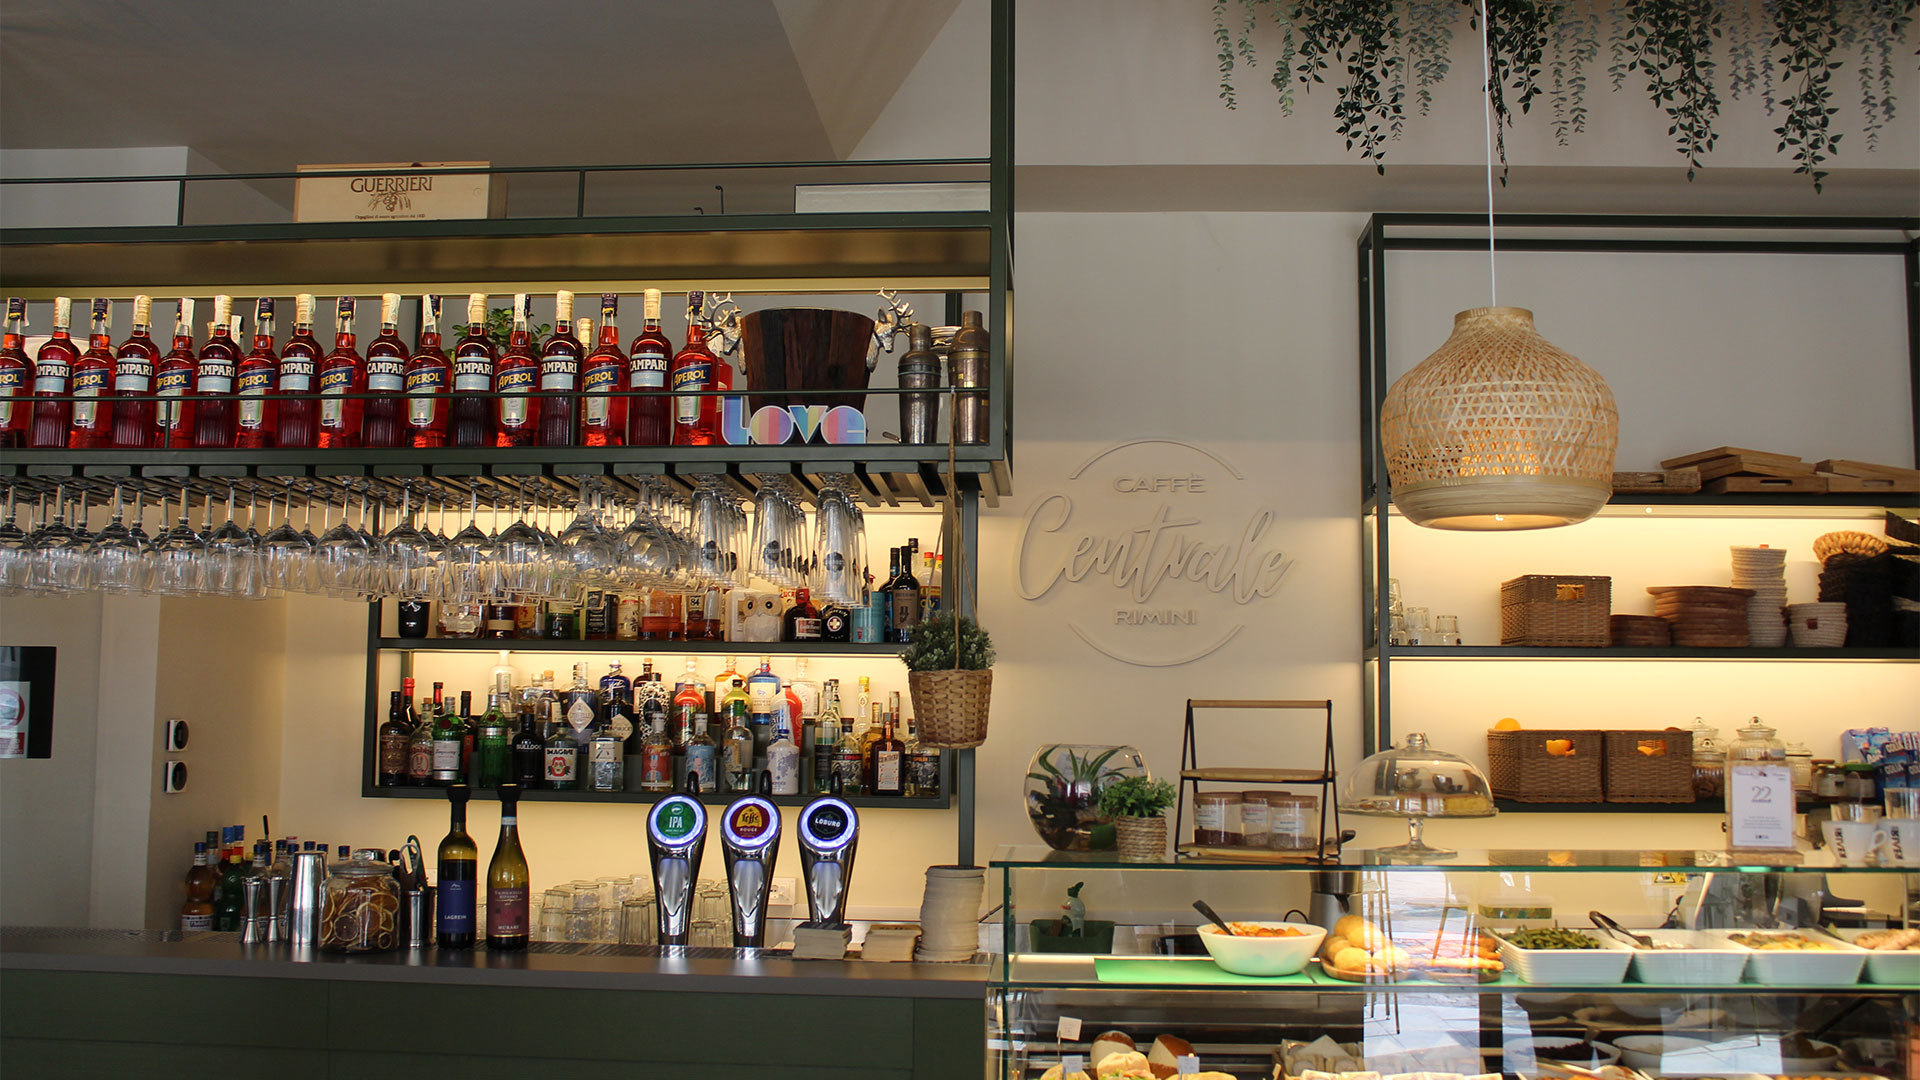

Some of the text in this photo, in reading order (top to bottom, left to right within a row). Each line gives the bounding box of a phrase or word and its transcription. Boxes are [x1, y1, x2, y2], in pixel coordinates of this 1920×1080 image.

[351, 176, 433, 192] GUERRIERI
[36, 365, 70, 378] AMPARI
[115, 363, 153, 376] AMPARI
[280, 362, 314, 375] AMPARI
[366, 362, 404, 374] CAMPAR
[0, 373, 20, 385] ROL
[406, 372, 441, 388] APEROL
[499, 372, 533, 388] APEROL
[673, 369, 706, 386] APEROL
[1113, 473, 1207, 493] CAFFÈ
[1014, 493, 1294, 605] Centrale
[1113, 609, 1197, 625] RIMINI
[1751, 785, 1772, 803] 22
[669, 816, 683, 829] IPA
[742, 811, 759, 824] Leffe
